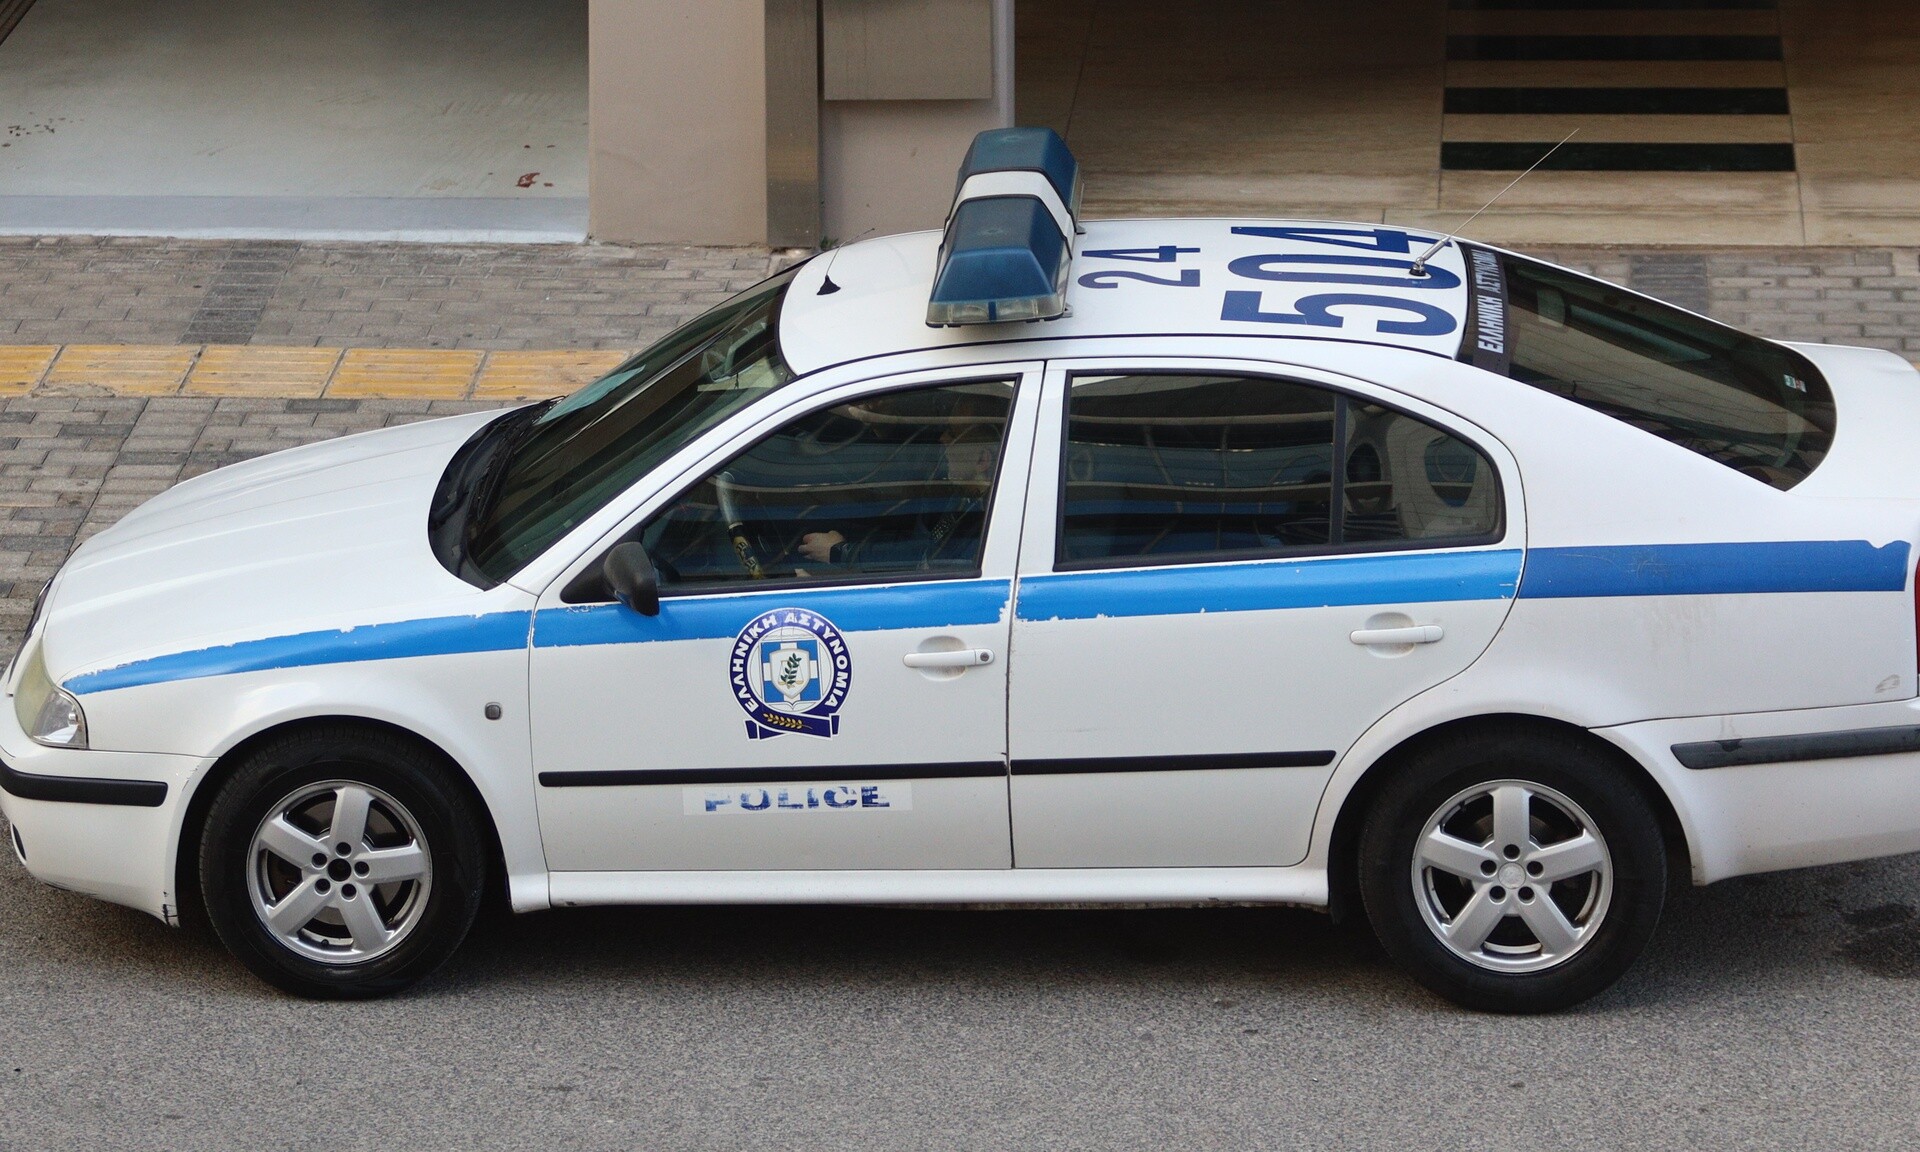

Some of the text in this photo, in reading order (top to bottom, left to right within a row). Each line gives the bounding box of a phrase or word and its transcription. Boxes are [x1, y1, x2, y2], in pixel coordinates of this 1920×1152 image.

[1078, 245, 1201, 289] 24
[1220, 226, 1462, 336] 504
[1477, 294, 1504, 354] ΕΛΛΗΝΙΚΗ
[732, 612, 849, 713] ΕΛΛΗΝΙΚΗ ΑΣΤΥΝΟΜΙΑ
